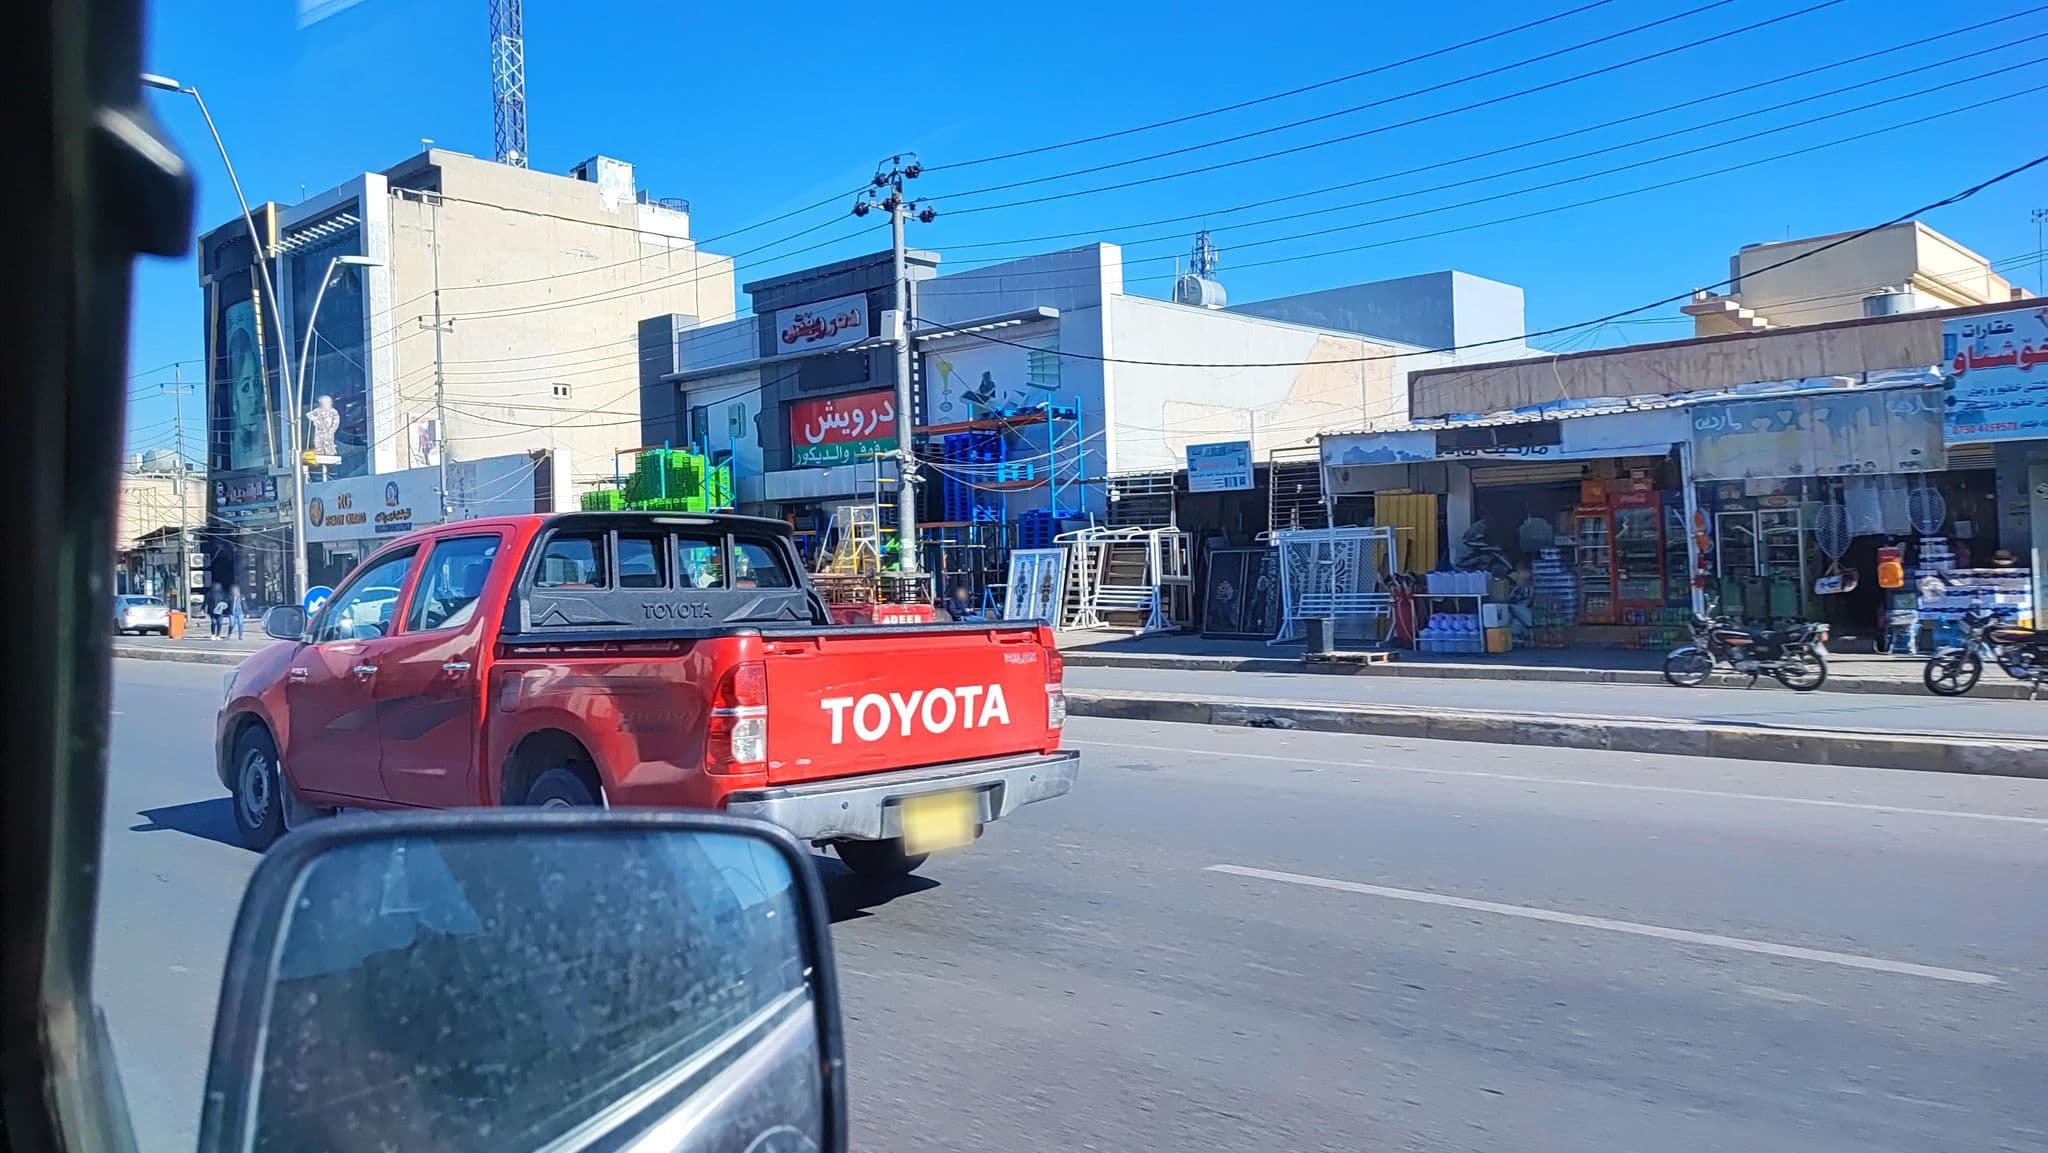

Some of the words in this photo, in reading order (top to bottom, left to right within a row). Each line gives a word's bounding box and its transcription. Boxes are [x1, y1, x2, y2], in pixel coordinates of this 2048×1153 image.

[1962, 320, 2014, 339] عقارات
[805, 400, 895, 444] درويش
[795, 444, 850, 466] والديكور
[642, 602, 713, 619] TOYOTA
[820, 683, 1010, 745] TOYOTA
